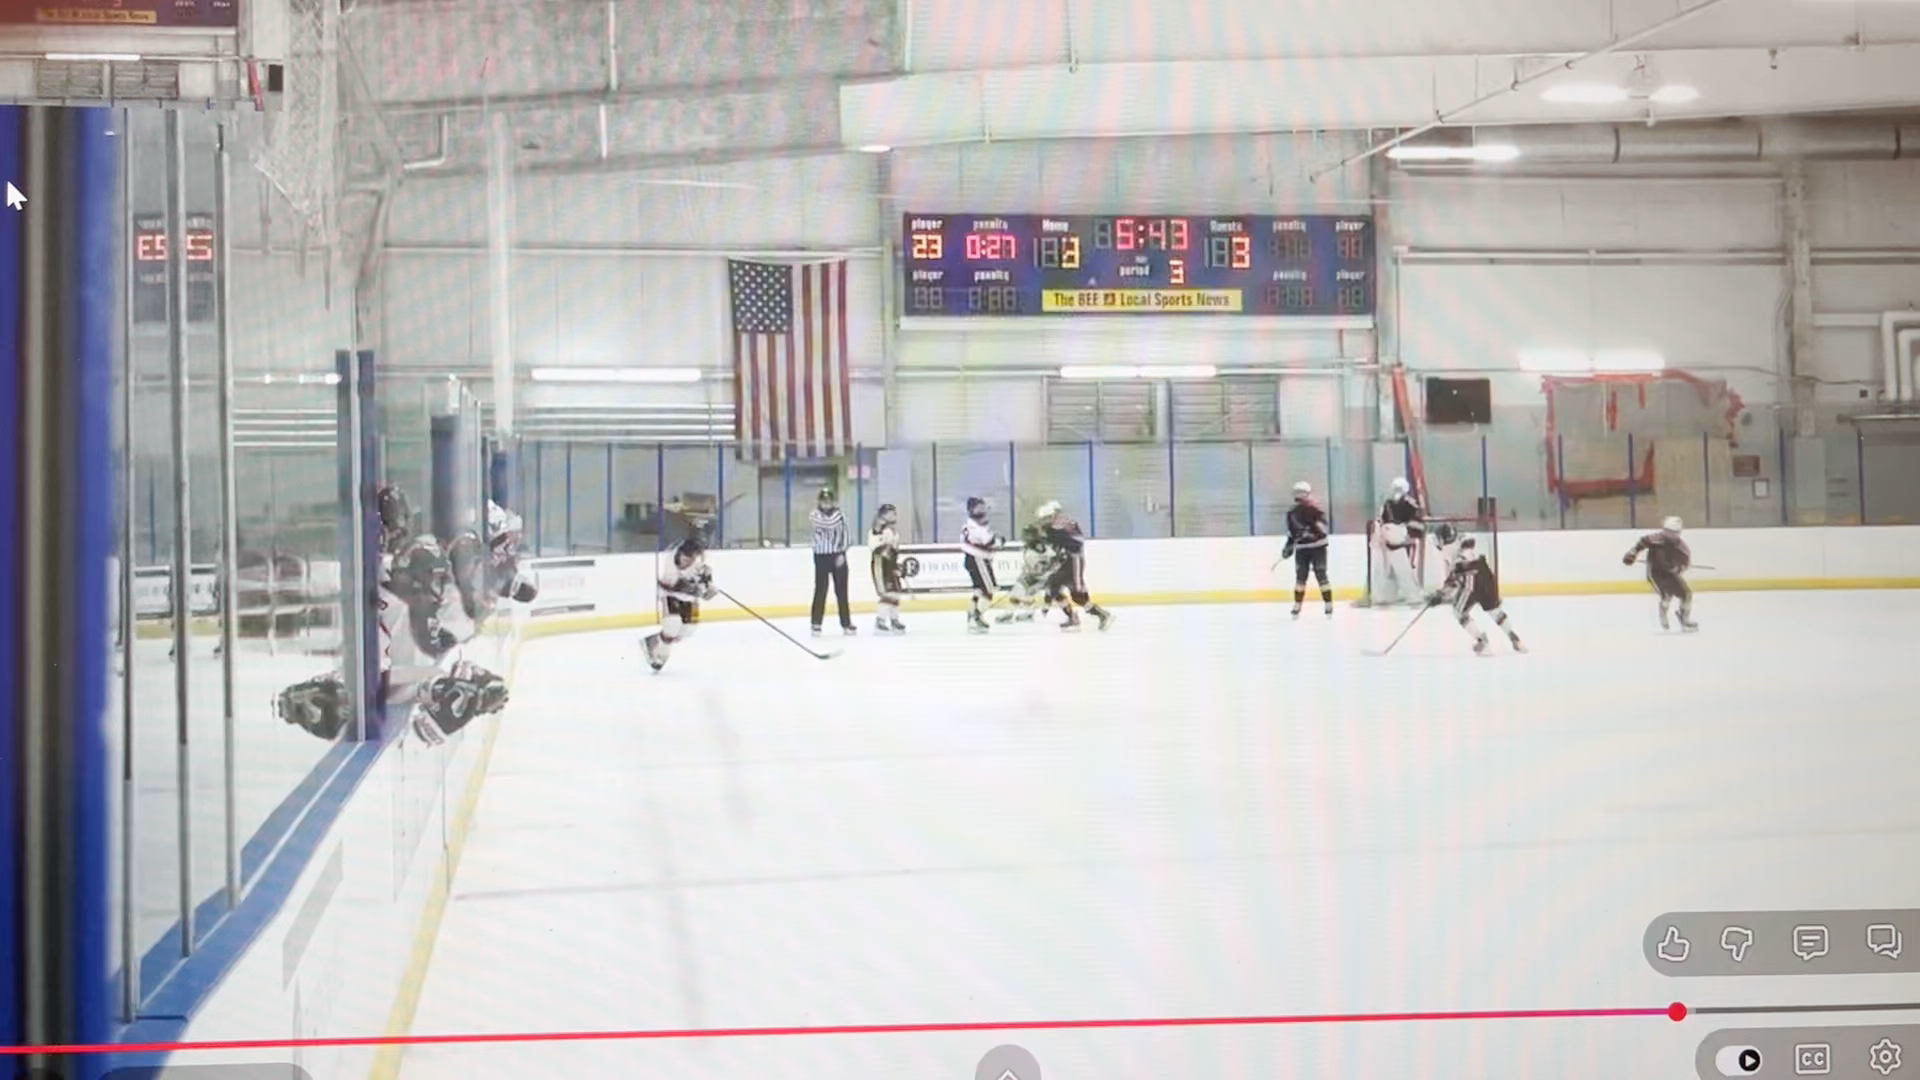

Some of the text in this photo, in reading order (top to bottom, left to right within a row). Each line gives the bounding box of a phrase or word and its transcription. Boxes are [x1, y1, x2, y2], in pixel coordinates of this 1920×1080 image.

[912, 234, 942, 259] 23
[966, 234, 1016, 259] 0:27
[1116, 219, 1188, 250] 5:43
[1168, 259, 1184, 284] 3
[1054, 292, 1230, 308] The BEE Local Sports News
[1801, 1052, 1824, 1065] CC
